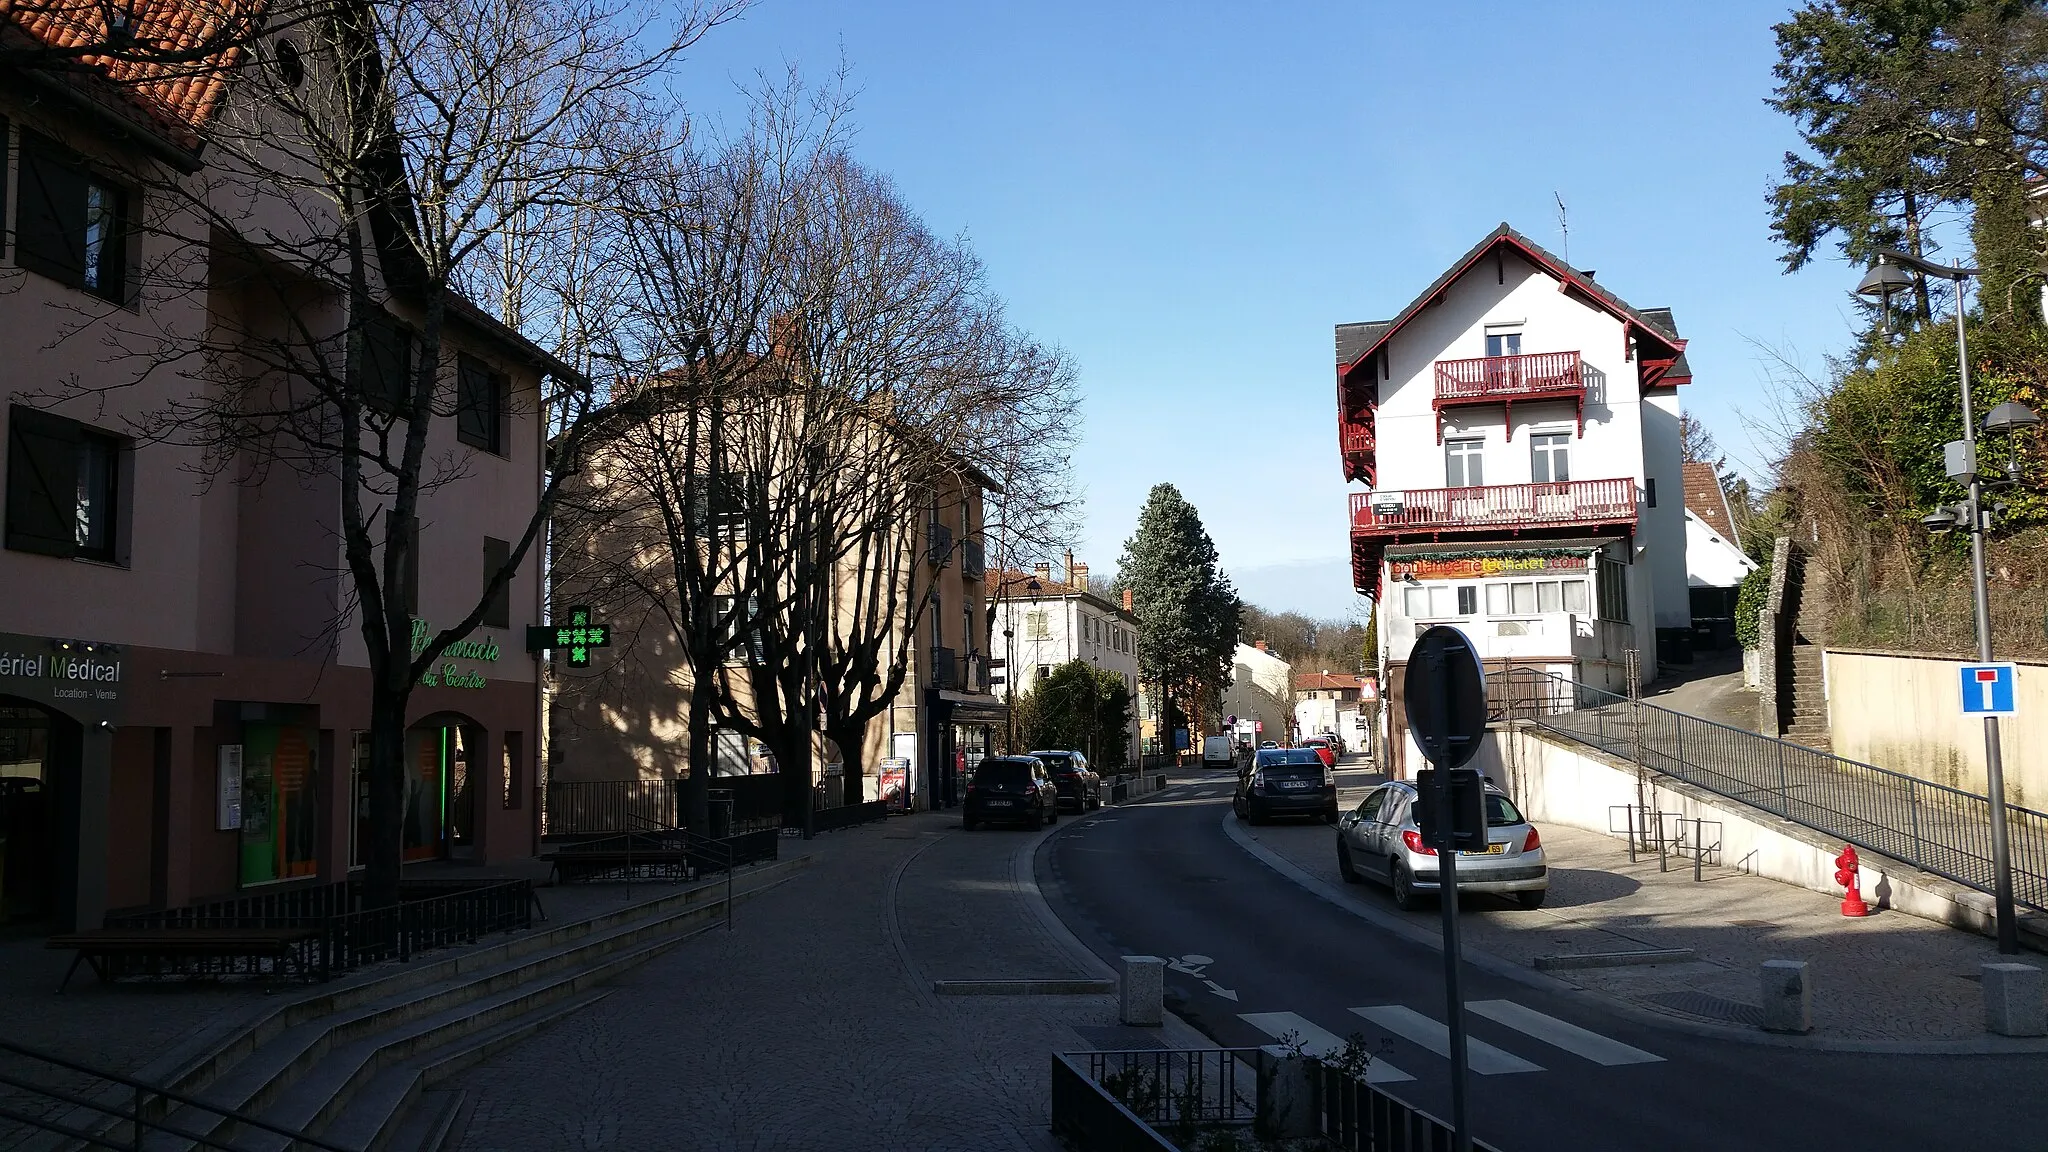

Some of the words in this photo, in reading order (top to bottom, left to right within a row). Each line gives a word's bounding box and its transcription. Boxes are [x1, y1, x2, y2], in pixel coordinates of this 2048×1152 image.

[50, 655, 120, 682] Médical
[443, 663, 487, 689] Centre
[54, 686, 88, 699] Location
[95, 688, 117, 700] Vente
[1491, 845, 1501, 853] 69
